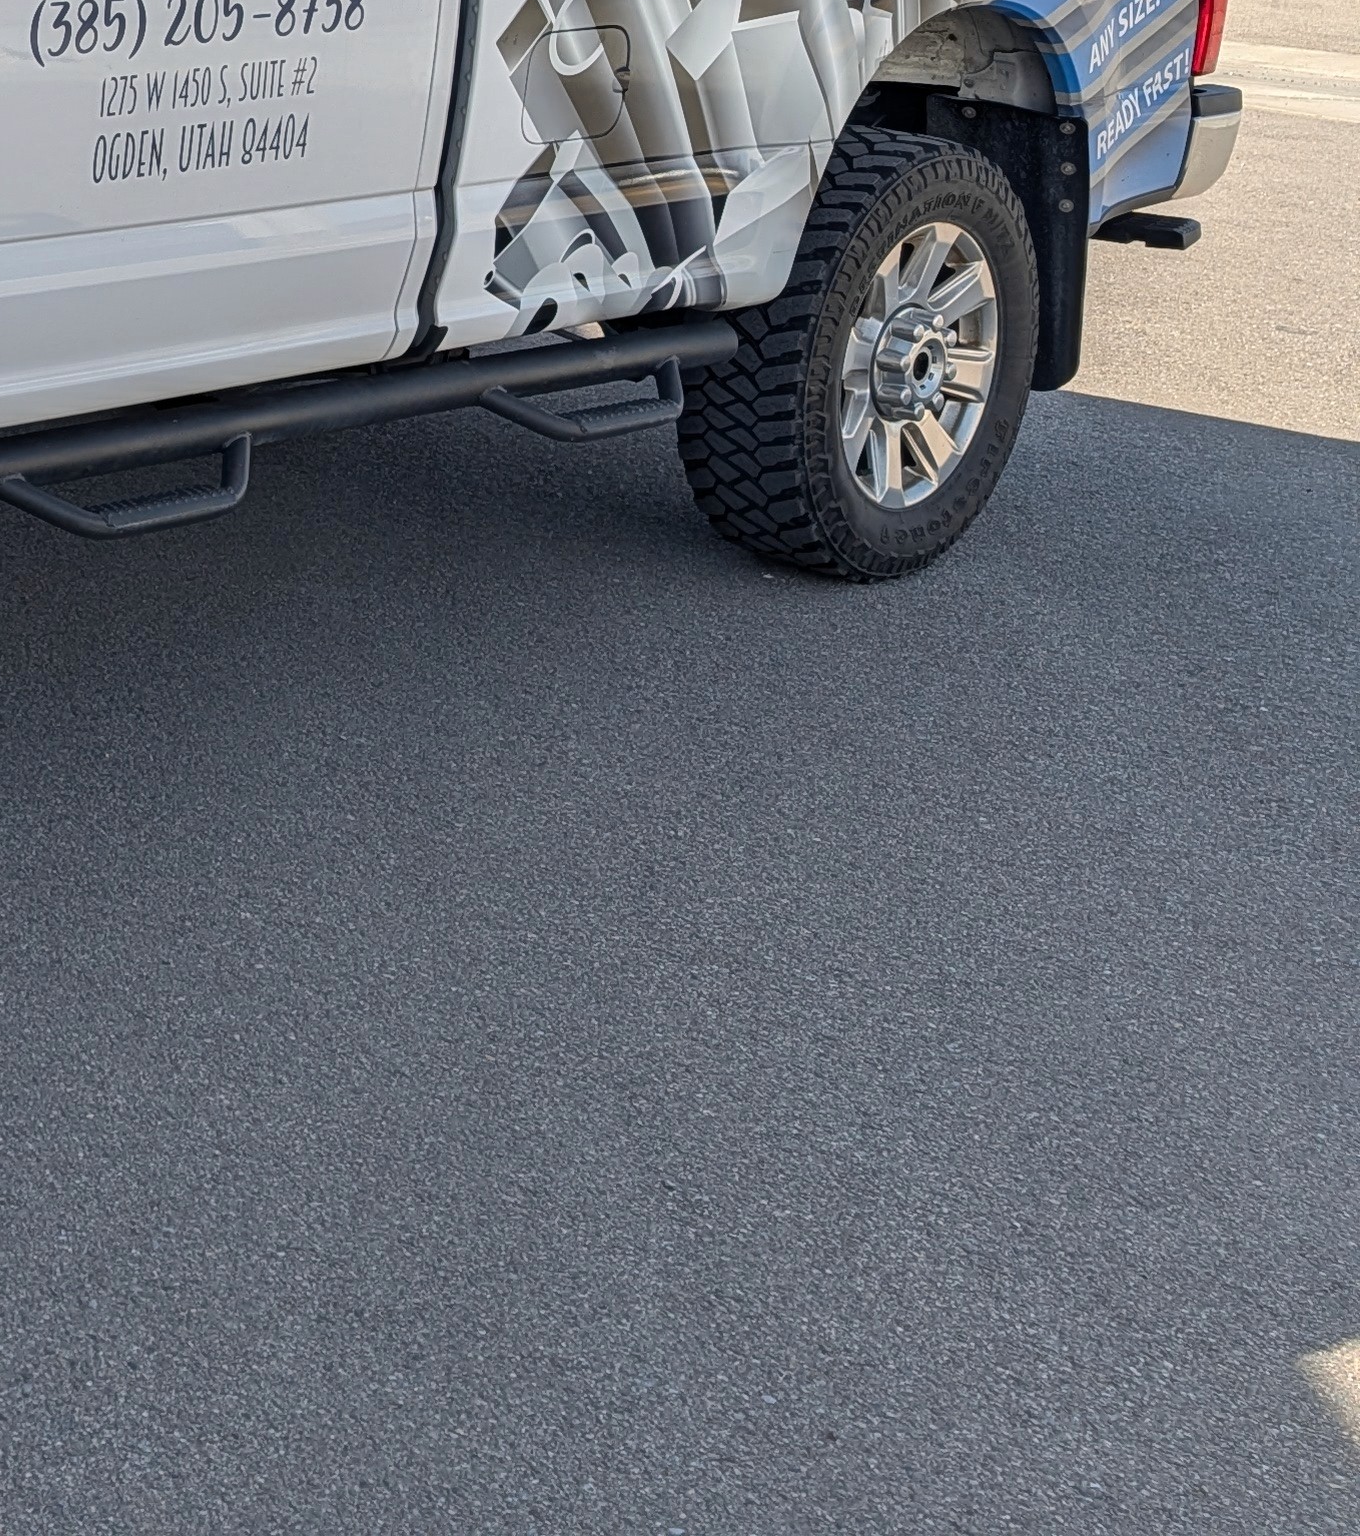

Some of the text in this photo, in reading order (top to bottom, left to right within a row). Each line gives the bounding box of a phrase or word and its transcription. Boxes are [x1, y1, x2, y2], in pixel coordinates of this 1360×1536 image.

[1088, 19, 1118, 74] ANY
[99, 74, 138, 118] 1275
[146, 71, 166, 113] W
[171, 65, 212, 110] 1450
[237, 58, 286, 102] SUITE
[291, 56, 319, 96] #2
[1096, 47, 1191, 160] READY FAST!
[92, 112, 310, 184] OGDEN, UTAH 84404
